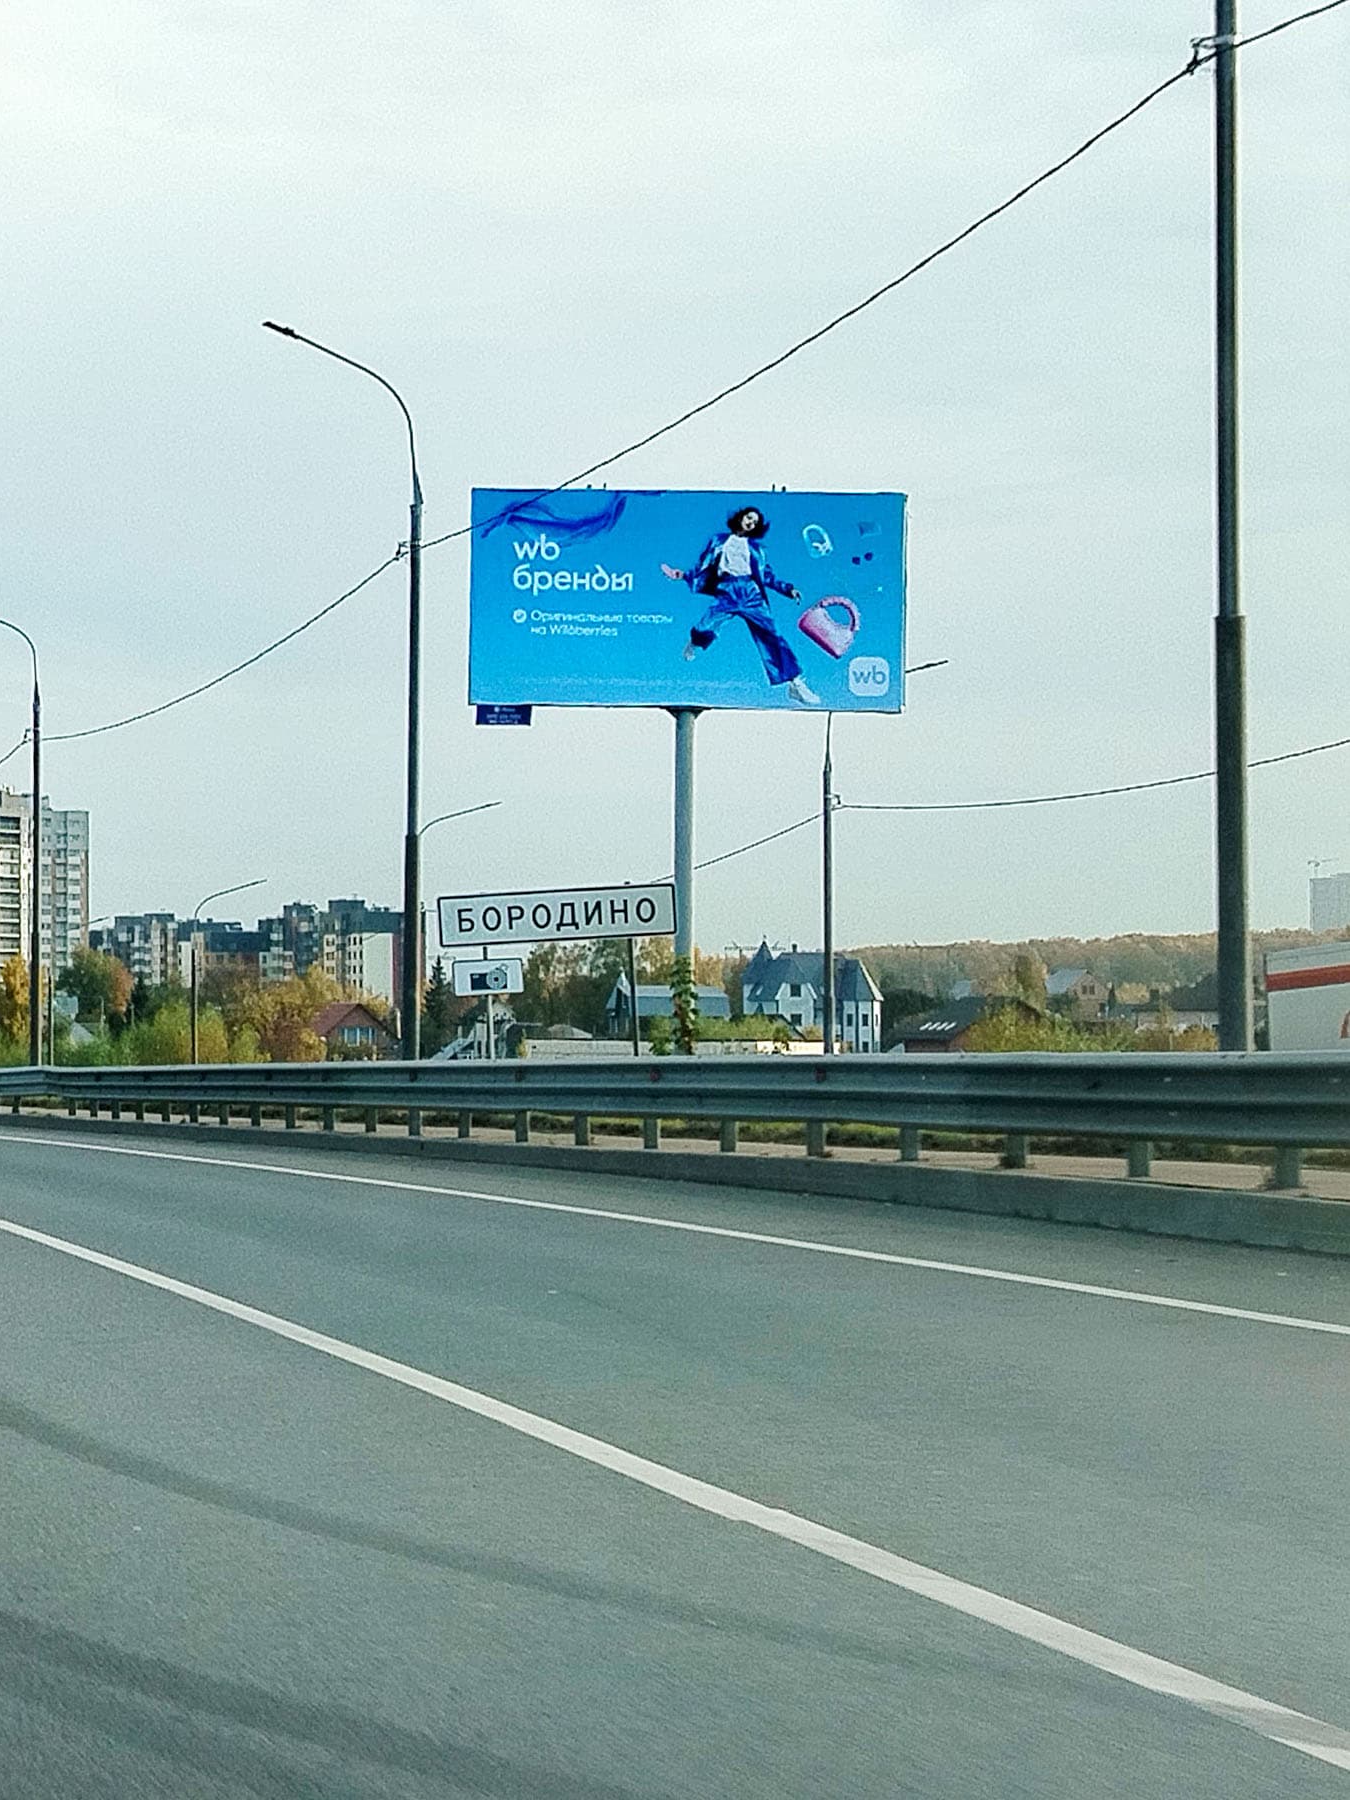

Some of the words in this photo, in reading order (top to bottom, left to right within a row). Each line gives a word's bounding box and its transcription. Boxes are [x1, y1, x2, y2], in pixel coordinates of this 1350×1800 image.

[513, 533, 561, 561] wb
[513, 563, 634, 596] бренды
[852, 665, 886, 685] wb
[456, 897, 657, 933] БОРОДИНО
